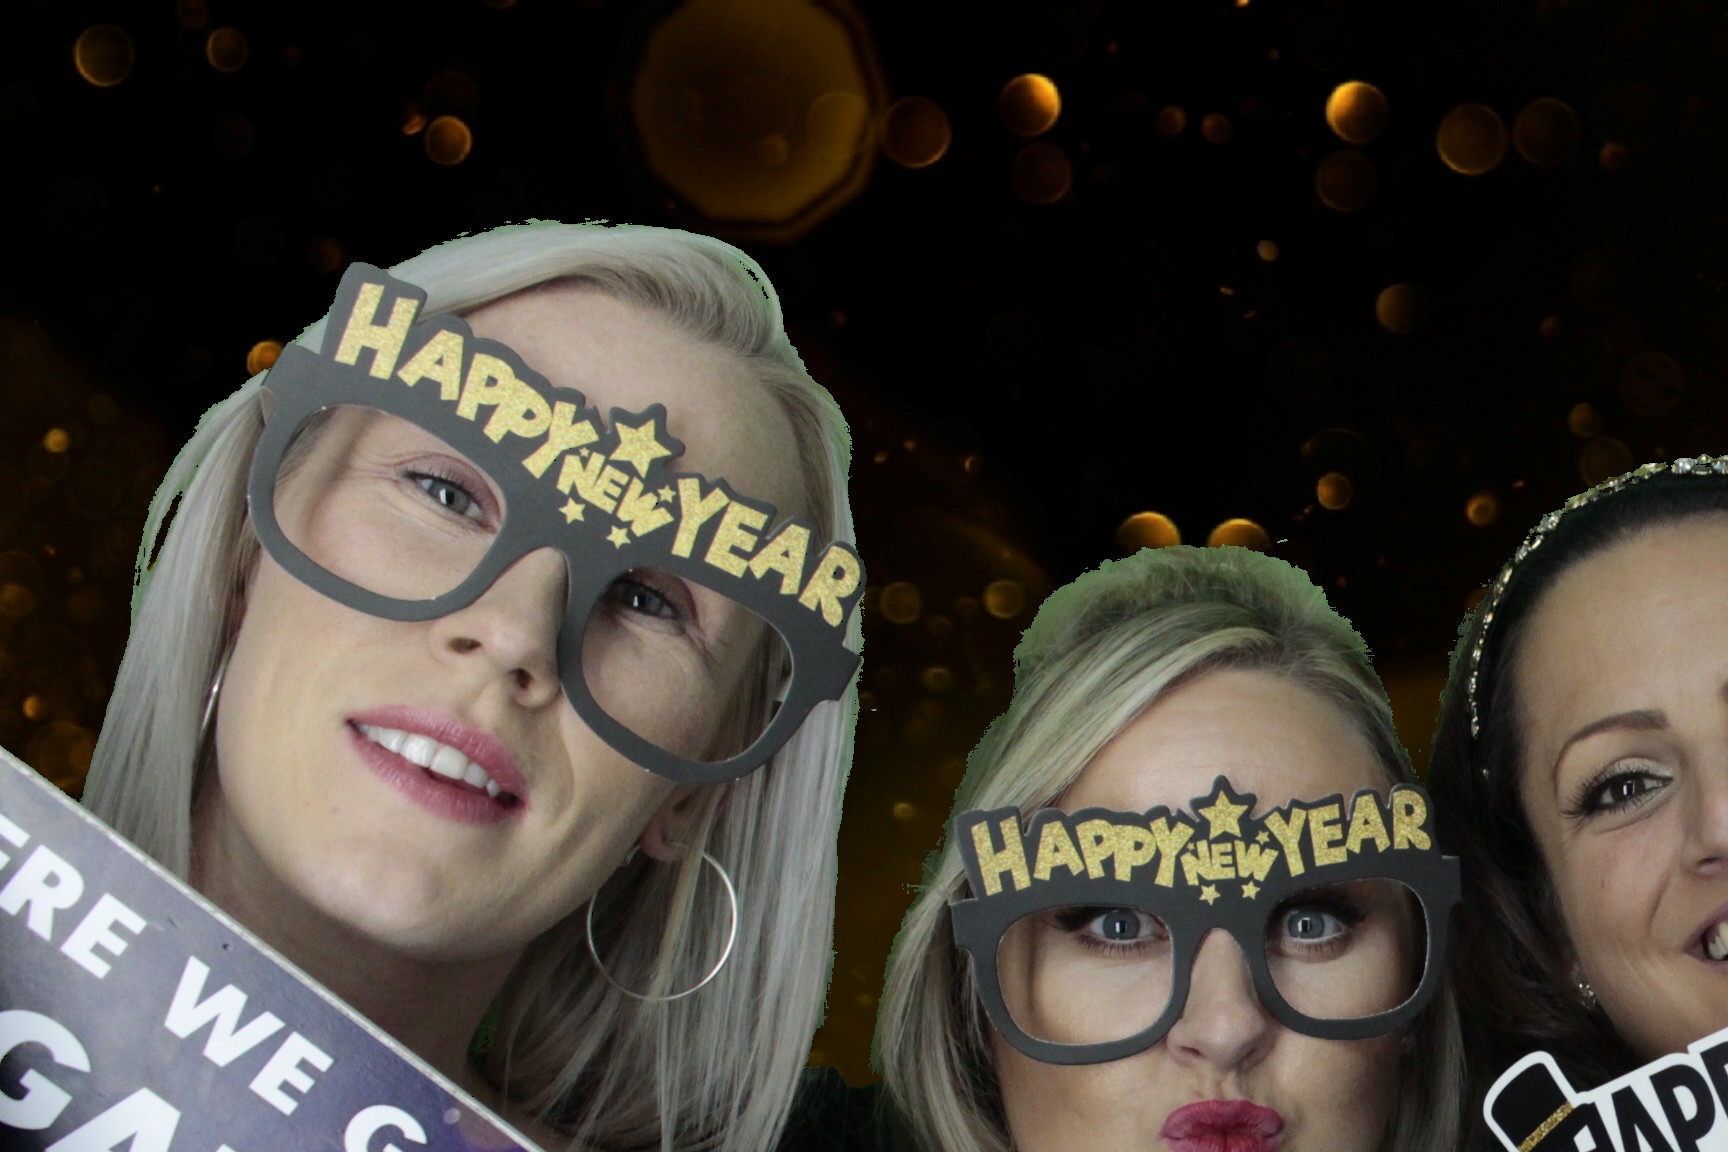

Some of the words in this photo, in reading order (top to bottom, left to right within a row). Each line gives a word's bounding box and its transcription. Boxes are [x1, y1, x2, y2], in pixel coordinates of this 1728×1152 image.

[334, 282, 598, 479] HAPPY
[556, 448, 675, 538] NEW
[671, 477, 861, 628] YEAR
[0, 812, 148, 980] RE
[163, 956, 334, 1117] WE
[970, 816, 1195, 897] HAPPY
[1181, 840, 1280, 886] NEW
[1263, 789, 1432, 878] YEAR
